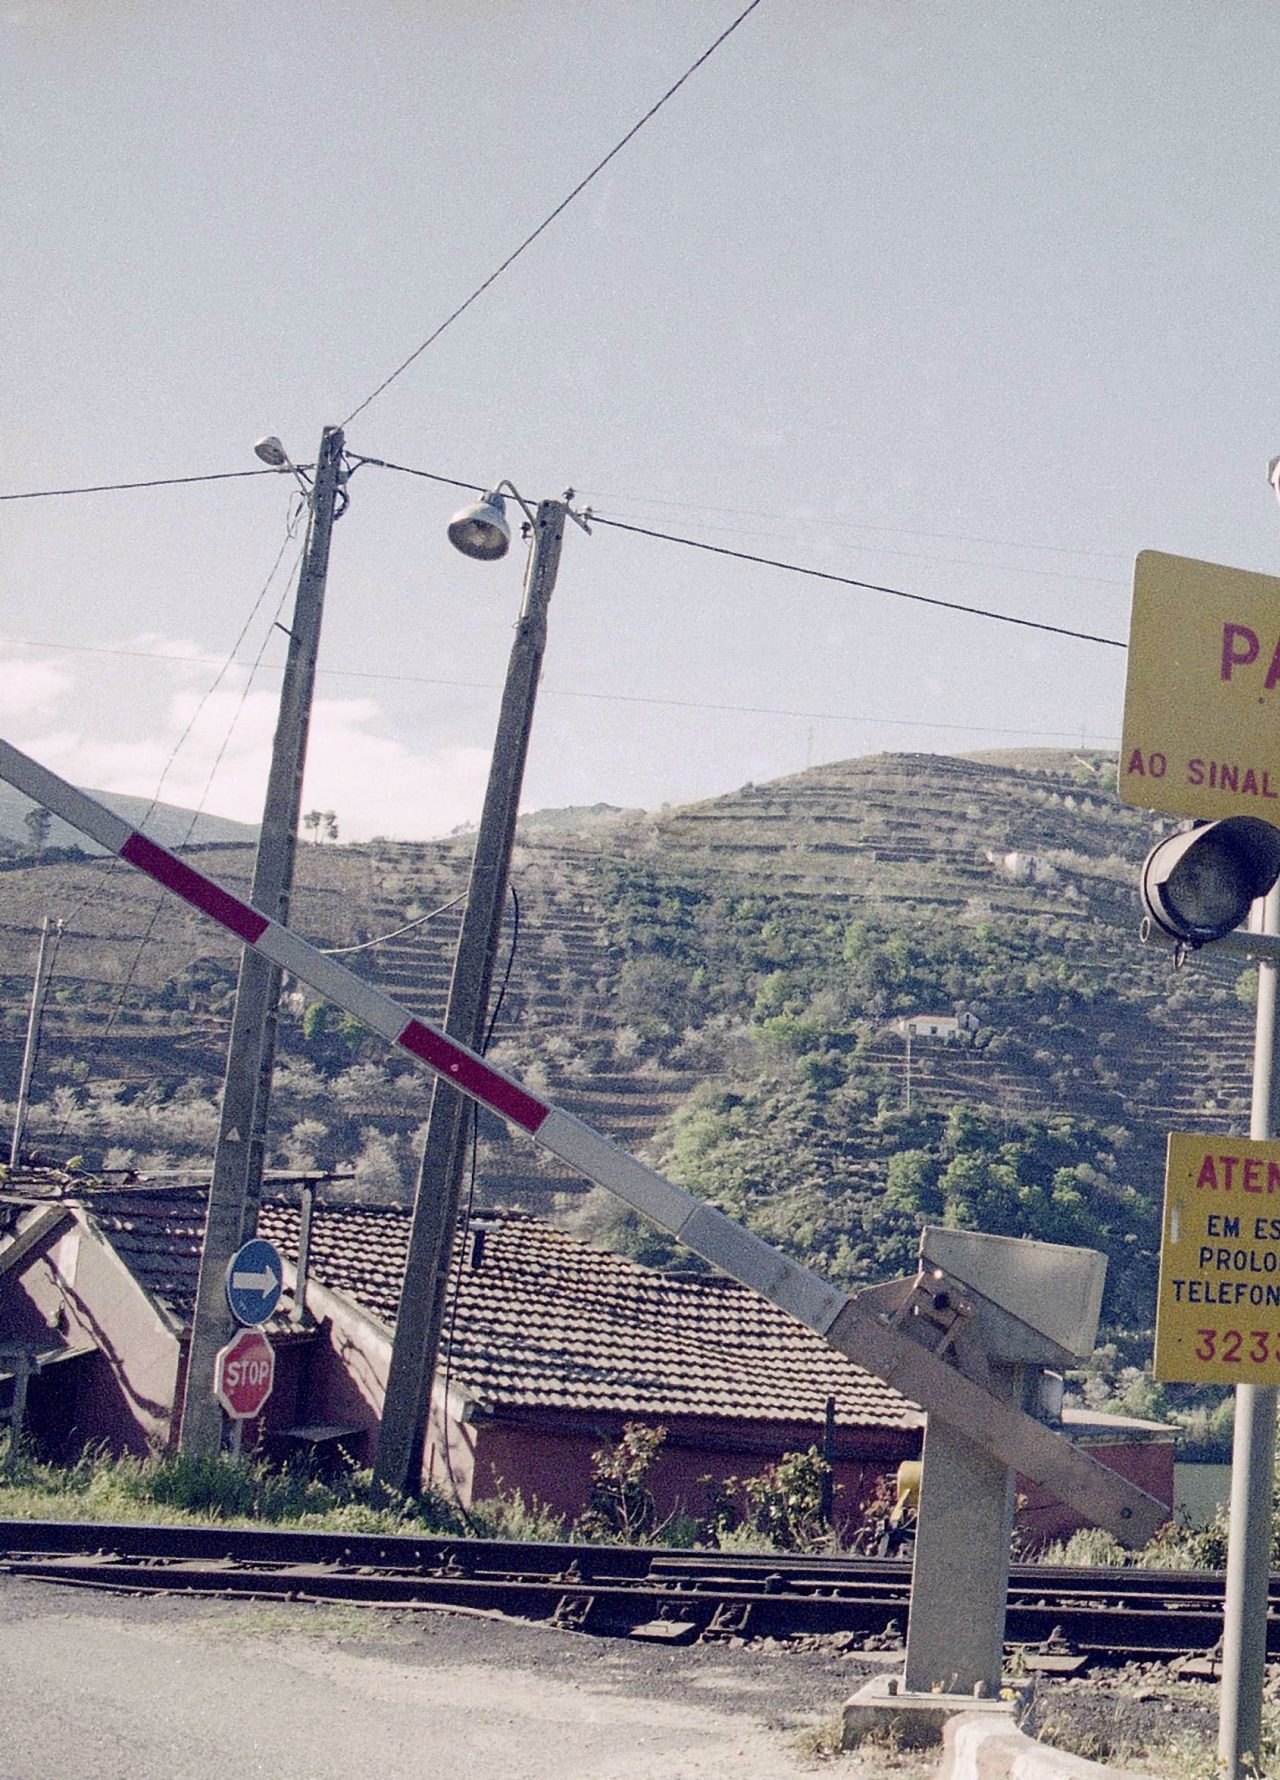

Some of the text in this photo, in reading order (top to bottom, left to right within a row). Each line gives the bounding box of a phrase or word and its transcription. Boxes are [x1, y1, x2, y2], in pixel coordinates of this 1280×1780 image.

[1127, 749, 1167, 778] AO
[1187, 758, 1279, 799] SINAL
[1207, 1214, 1240, 1238] EM
[227, 1361, 270, 1387] STOP
